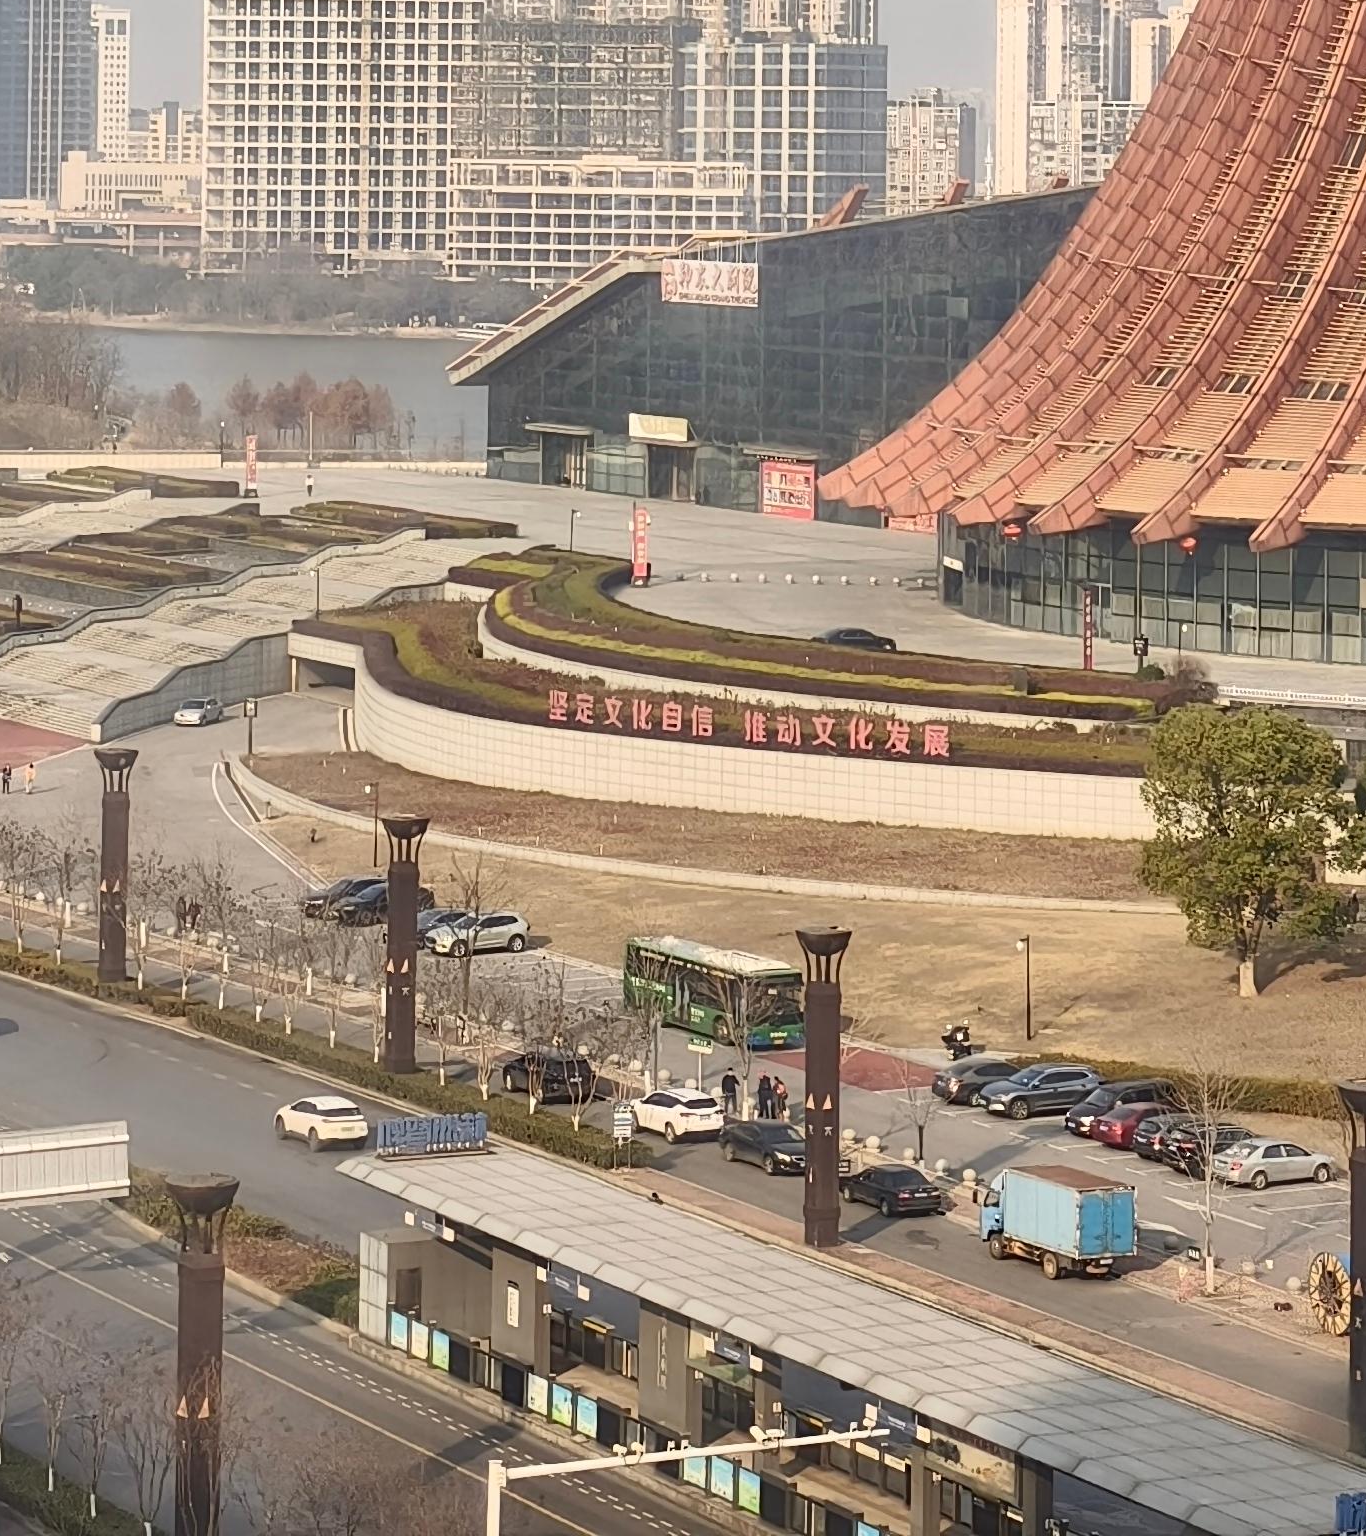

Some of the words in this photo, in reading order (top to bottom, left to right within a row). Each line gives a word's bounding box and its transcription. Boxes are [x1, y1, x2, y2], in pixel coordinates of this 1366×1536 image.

[549, 689, 714, 738] 坚定文化自信
[744, 709, 950, 758] 推动文化发展
